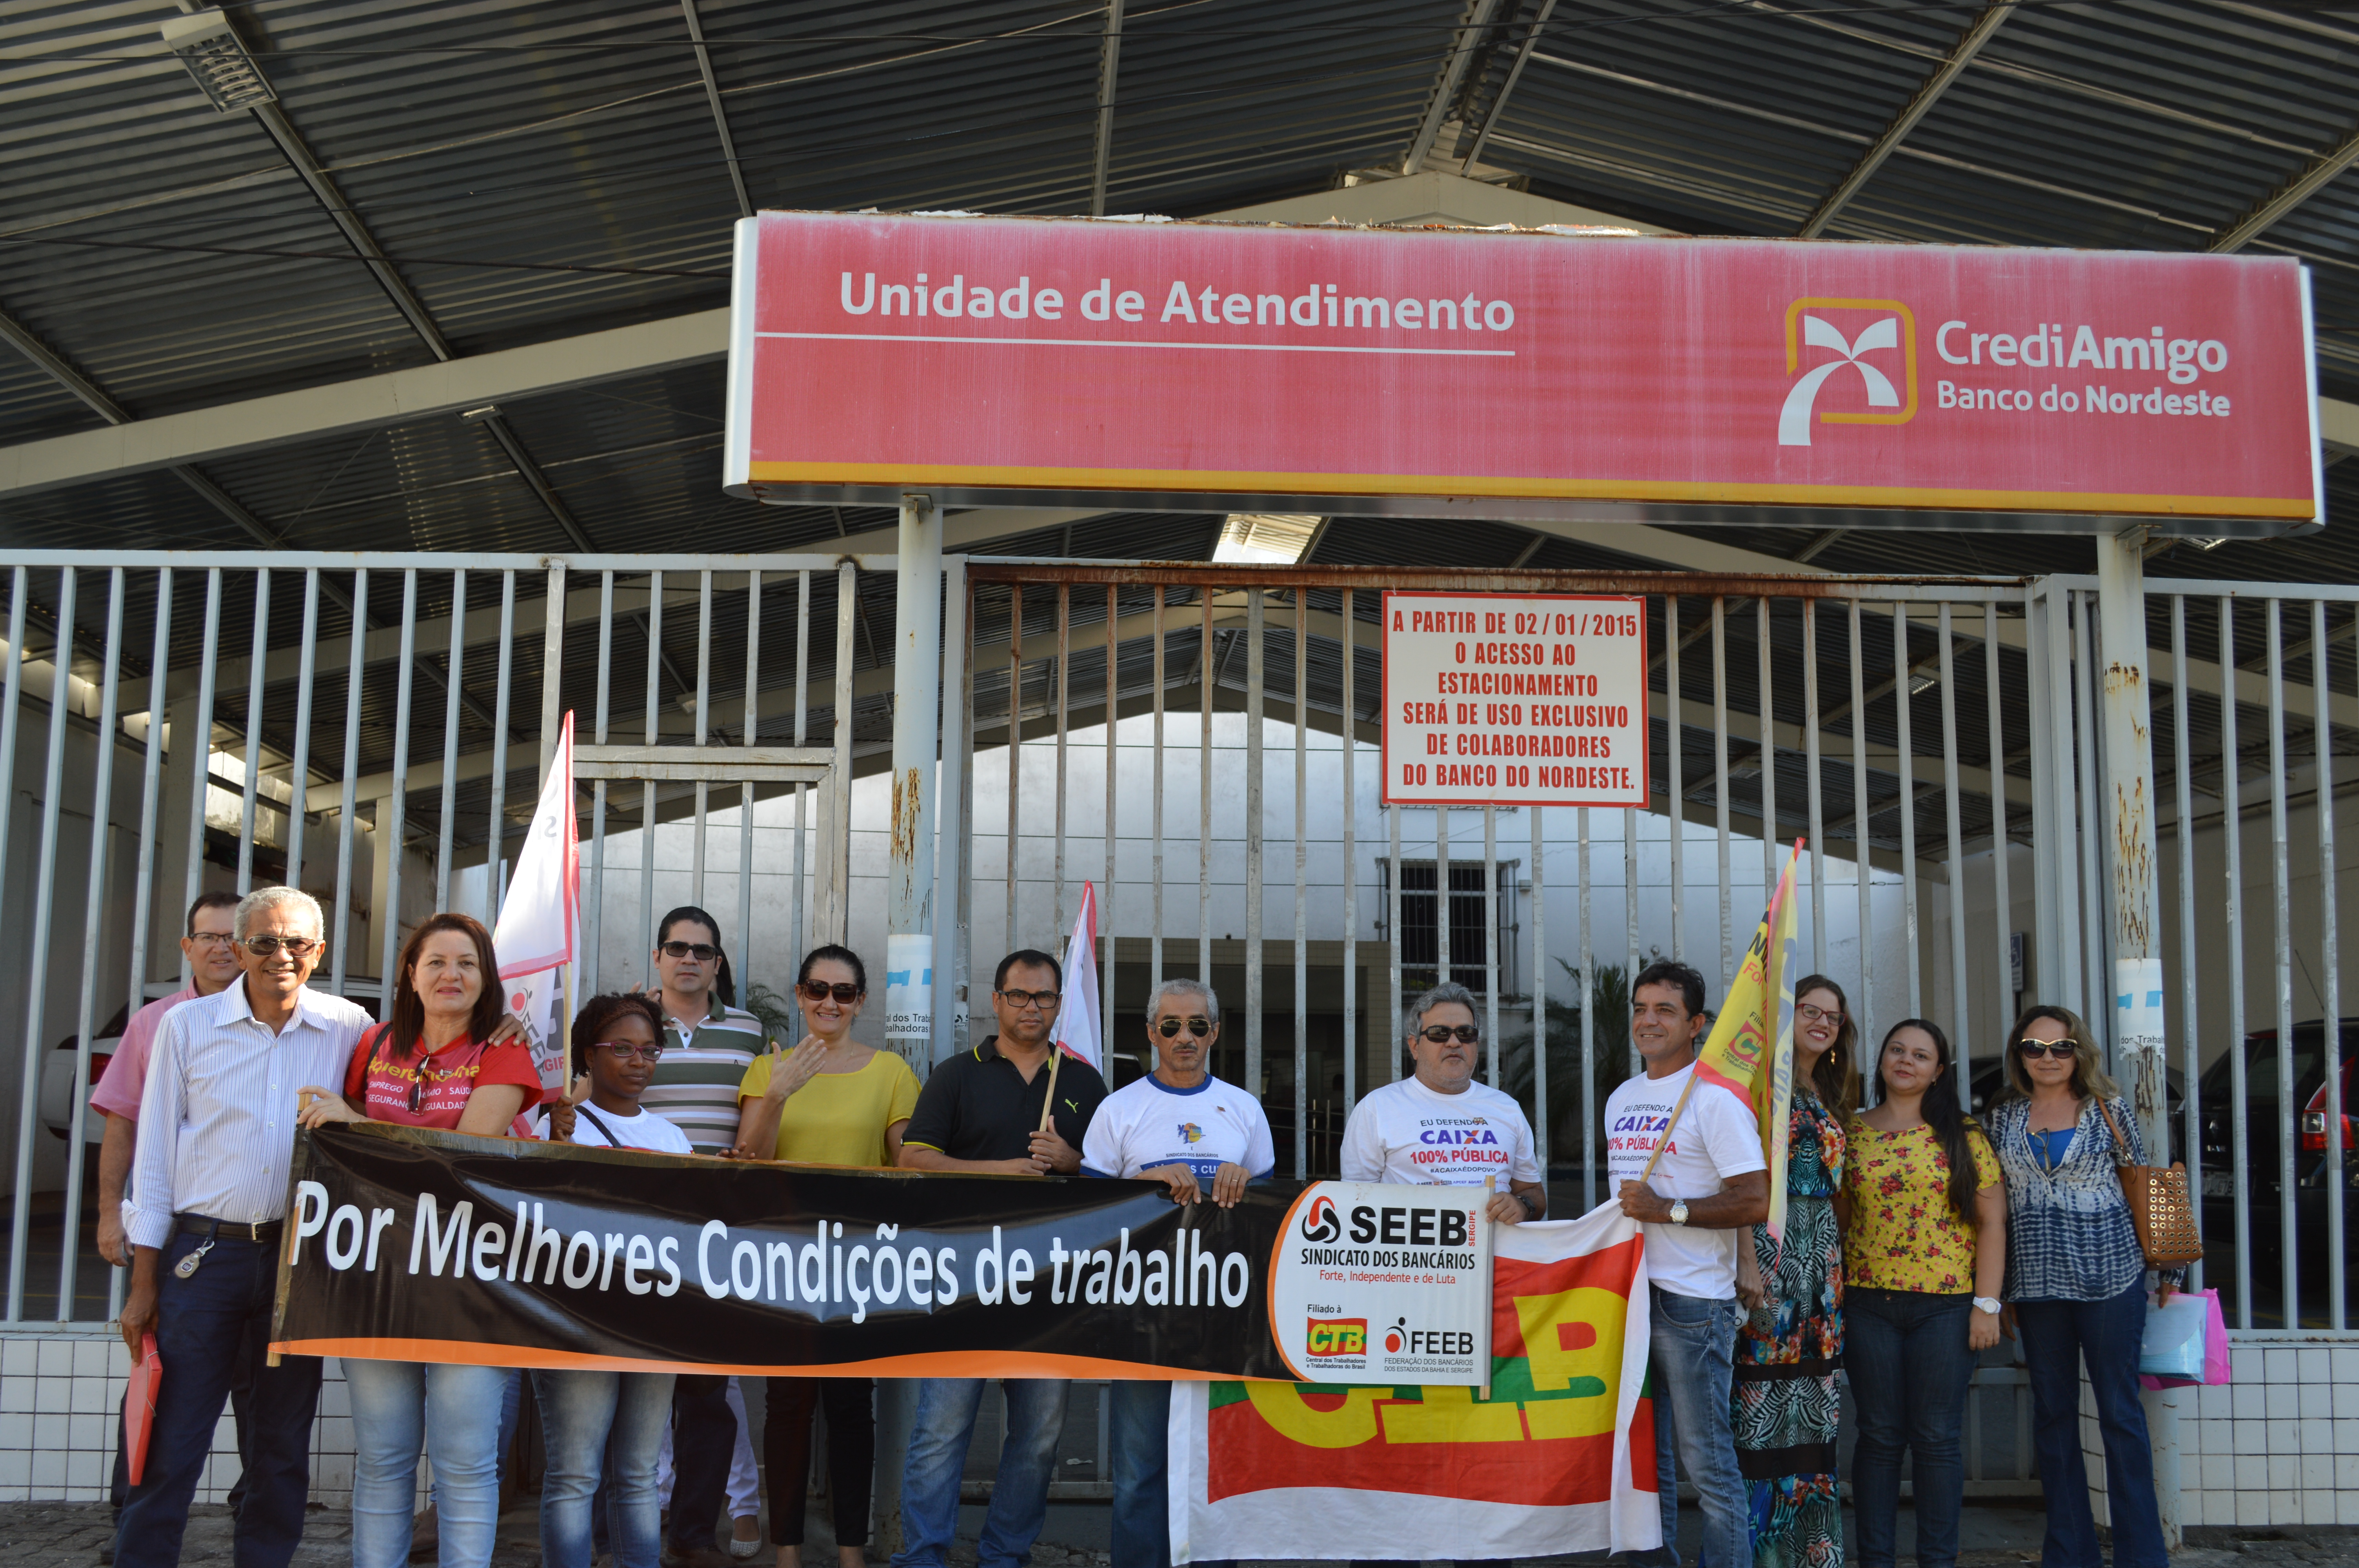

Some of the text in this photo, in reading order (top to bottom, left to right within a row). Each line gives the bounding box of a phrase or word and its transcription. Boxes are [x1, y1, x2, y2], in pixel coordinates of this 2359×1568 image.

[841, 271, 1515, 332] Unidade de Atendimento
[1936, 320, 2228, 384] CrediAmigo
[1937, 380, 2231, 417] Banco do Nordeste
[1393, 611, 1404, 632] A
[1413, 611, 1476, 633] PARTIR
[1485, 612, 1506, 633] DE
[1456, 642, 1576, 666] O ACESSO AO
[1438, 672, 1598, 697] ESTACIONAMENTO
[1403, 699, 1628, 728] SERÁ DE USO EXCLUSIVO
[1427, 733, 1611, 759] DE COLABORADORES
[1403, 763, 1635, 789] DO BANCO DO NORDESTE.
[893, 1013, 909, 1022] dos
[1614, 1116, 1671, 1133] CAIXA
[1420, 1130, 1498, 1144] CAIXA
[1410, 1147, 1508, 1164] 100% PÚBLICA
[1349, 1206, 1467, 1247] SEEB
[287, 1180, 1249, 1324] Por Melhores Condições de trabalho
[1301, 1249, 1475, 1270] SINDICATO DOS BANCÁRIOS
[1319, 1270, 1456, 1284] Forte, Independente e de Luta
[1307, 1304, 1341, 1314] Filiado à
[1309, 1323, 1365, 1353] CTB
[1411, 1331, 1474, 1355] FEEB
[1385, 1357, 1422, 1366] FEDERAÇÃO
[1438, 1357, 1474, 1366] BANCÁRIOS
